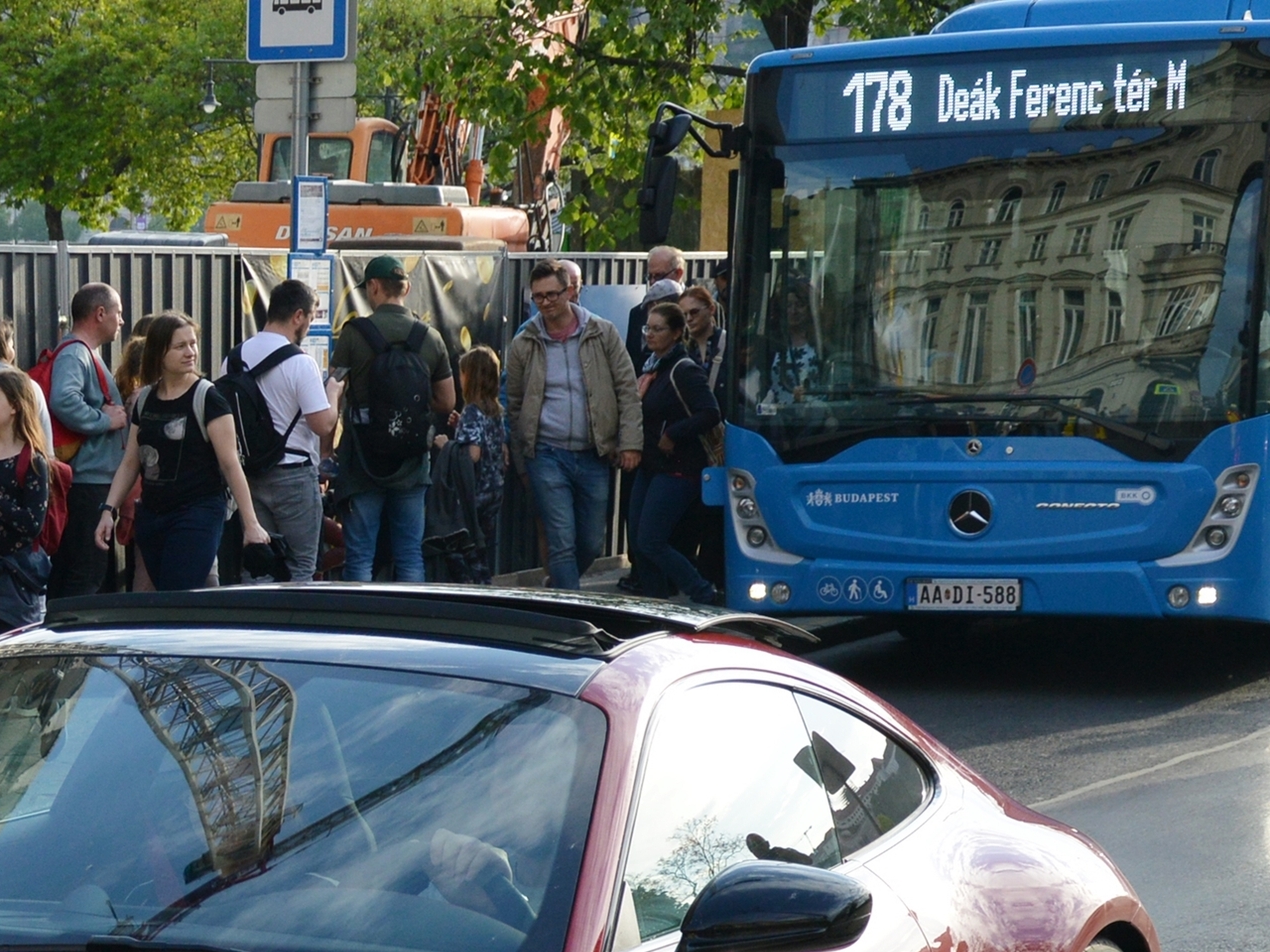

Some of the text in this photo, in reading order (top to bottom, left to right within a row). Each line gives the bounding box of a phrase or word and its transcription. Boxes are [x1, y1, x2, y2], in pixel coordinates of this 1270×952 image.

[843, 59, 1186, 133] 178 Deák Ferenc tér M
[275, 225, 373, 241] DSAN
[834, 493, 899, 503] BUDAPEST
[1120, 491, 1138, 499] BKK
